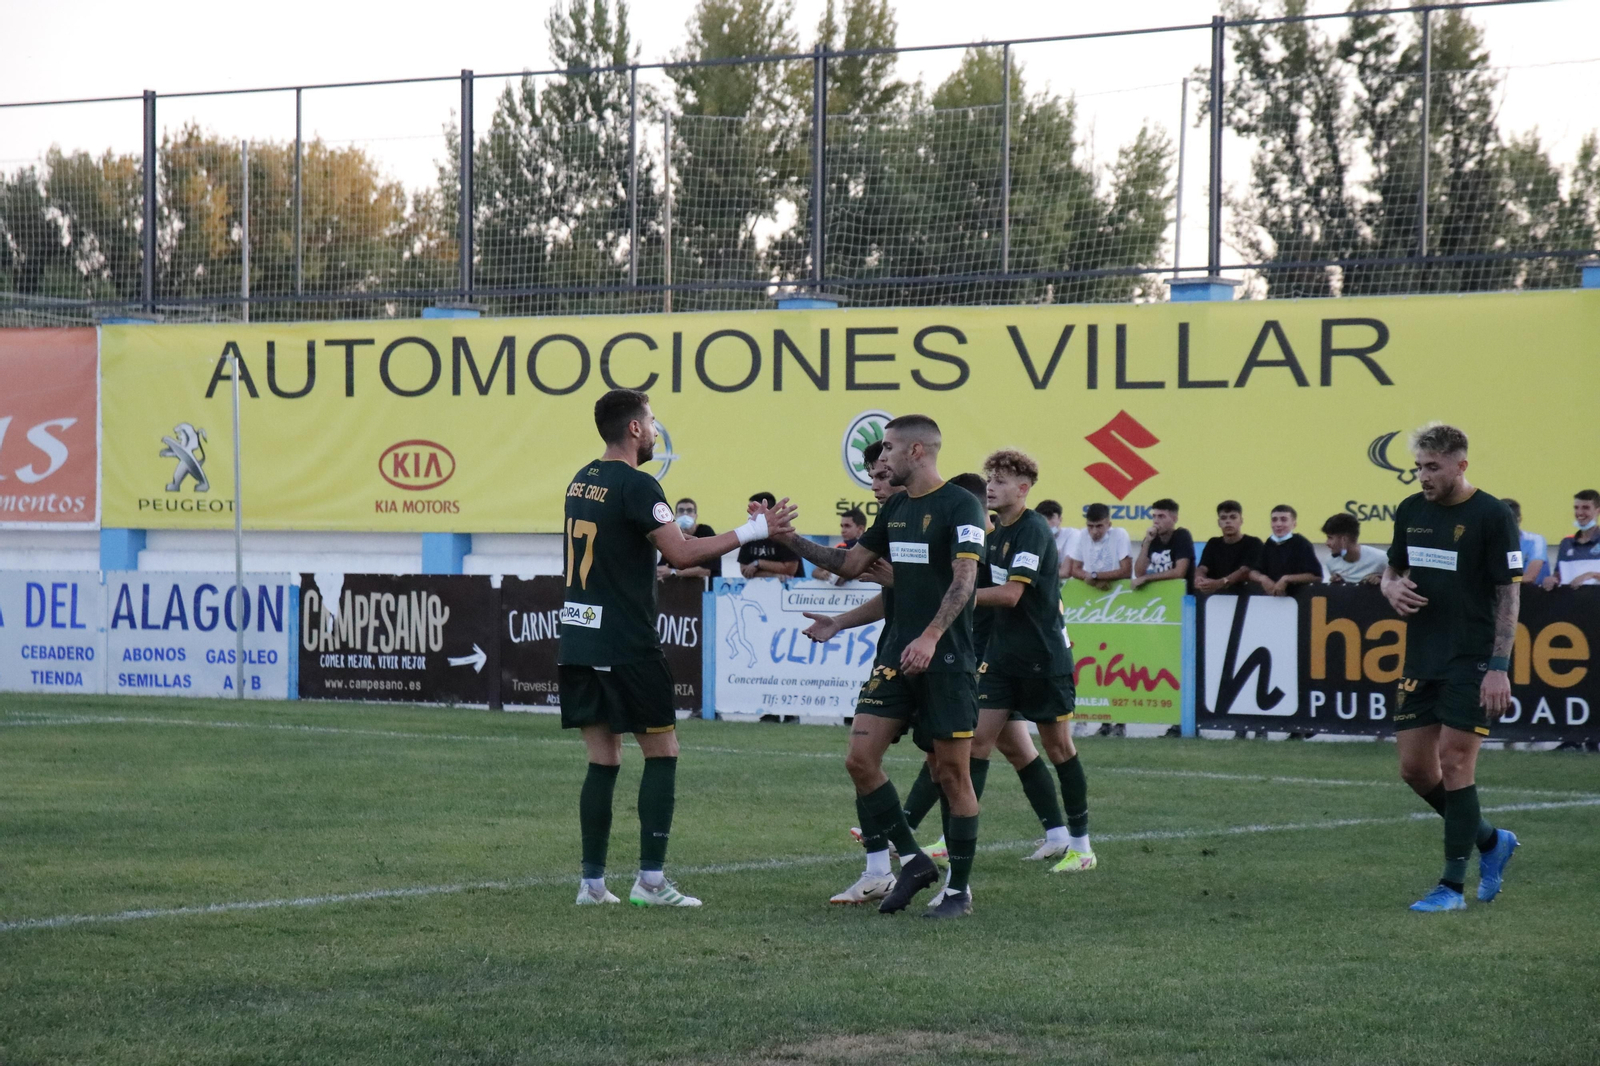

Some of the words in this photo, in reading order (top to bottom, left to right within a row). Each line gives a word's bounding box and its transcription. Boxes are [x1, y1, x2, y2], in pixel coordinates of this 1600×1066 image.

[205, 325, 970, 399] AUTOMOCIONES
[1006, 318, 1395, 391] VILLAR
[0, 416, 78, 484] S
[393, 452, 443, 478] KIA
[585, 484, 608, 503] CRUZ
[138, 498, 237, 513] PEUGEOT
[375, 500, 398, 514] KIA
[402, 500, 460, 515] MOTORS
[1345, 500, 1397, 522] SSAN
[567, 518, 598, 590] 17
[26, 582, 86, 629] DEL
[788, 592, 826, 606] Clínica
[828, 593, 840, 606] de
[111, 583, 284, 633] ALAGON
[303, 589, 450, 654] CAMPESANO
[656, 613, 699, 648] ONES
[21, 644, 95, 662] CEBADERO
[123, 648, 186, 662] ABONOS
[320, 654, 345, 669] COMER
[348, 654, 376, 670] MEJOR,
[378, 655, 399, 670] VIVIR
[402, 655, 427, 670] MEJOR
[31, 670, 84, 687] TIENDA
[118, 673, 192, 688] SEMILLAS
[222, 675, 234, 690] A
[251, 676, 262, 690] B
[325, 679, 422, 692] www.campesano.es
[728, 673, 779, 686] Concertada
[781, 677, 798, 687] con
[674, 684, 695, 696] RIA
[781, 694, 797, 706] 927
[800, 695, 812, 706] 50
[814, 695, 826, 707] 60
[829, 695, 840, 707] 73
